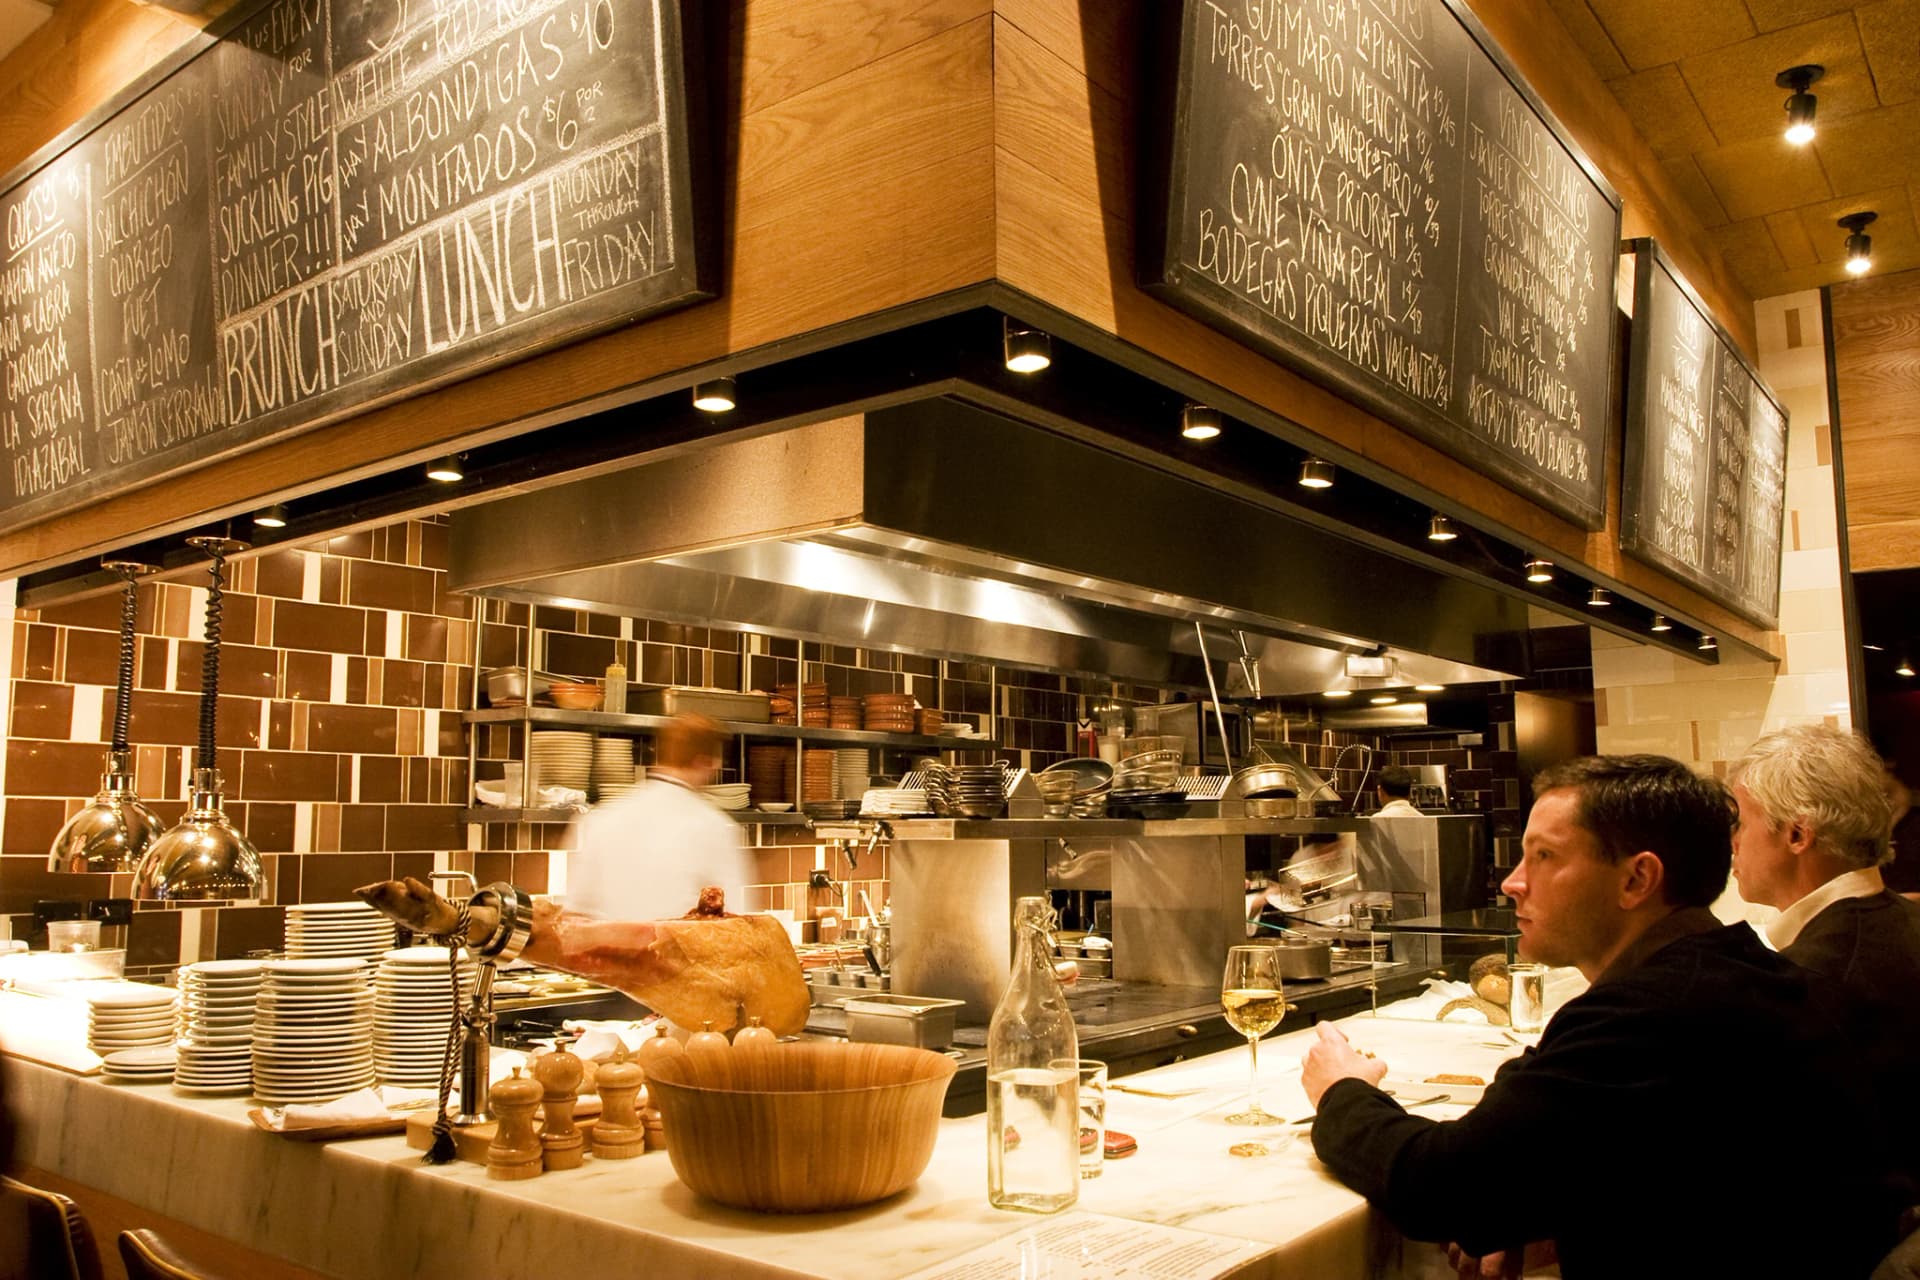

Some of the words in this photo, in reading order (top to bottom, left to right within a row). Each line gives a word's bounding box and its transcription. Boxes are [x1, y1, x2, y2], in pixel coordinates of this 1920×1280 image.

[289, 47, 313, 81] FOR
[569, 0, 615, 55] $10
[1205, 0, 1276, 105] TORRES
[1326, 104, 1373, 181] SANGRE
[215, 118, 279, 203] FAMILY
[283, 87, 332, 161] STYLE
[379, 104, 537, 241] MONTADOS
[542, 90, 578, 151] $6
[554, 142, 641, 213] MONDAY
[572, 191, 640, 231] THROUGH
[1476, 176, 1516, 248] TORRES
[1545, 145, 1590, 233] BLANCOS
[331, 246, 417, 320] SATURDAY
[417, 175, 568, 354] LUNCH
[562, 210, 656, 302] FRIDAY
[1198, 208, 1299, 321] BODEGAS
[1350, 245, 1397, 323] REAL
[32, 279, 72, 335] CABRA
[122, 276, 162, 345] FUET
[337, 301, 413, 377] SUNDAY
[359, 300, 386, 330] AND
[1497, 290, 1519, 349] VAL
[101, 357, 137, 417] CAÑA
[148, 327, 191, 389] LOMO
[223, 280, 340, 426] BRUNCH
[3, 410, 21, 450] LA
